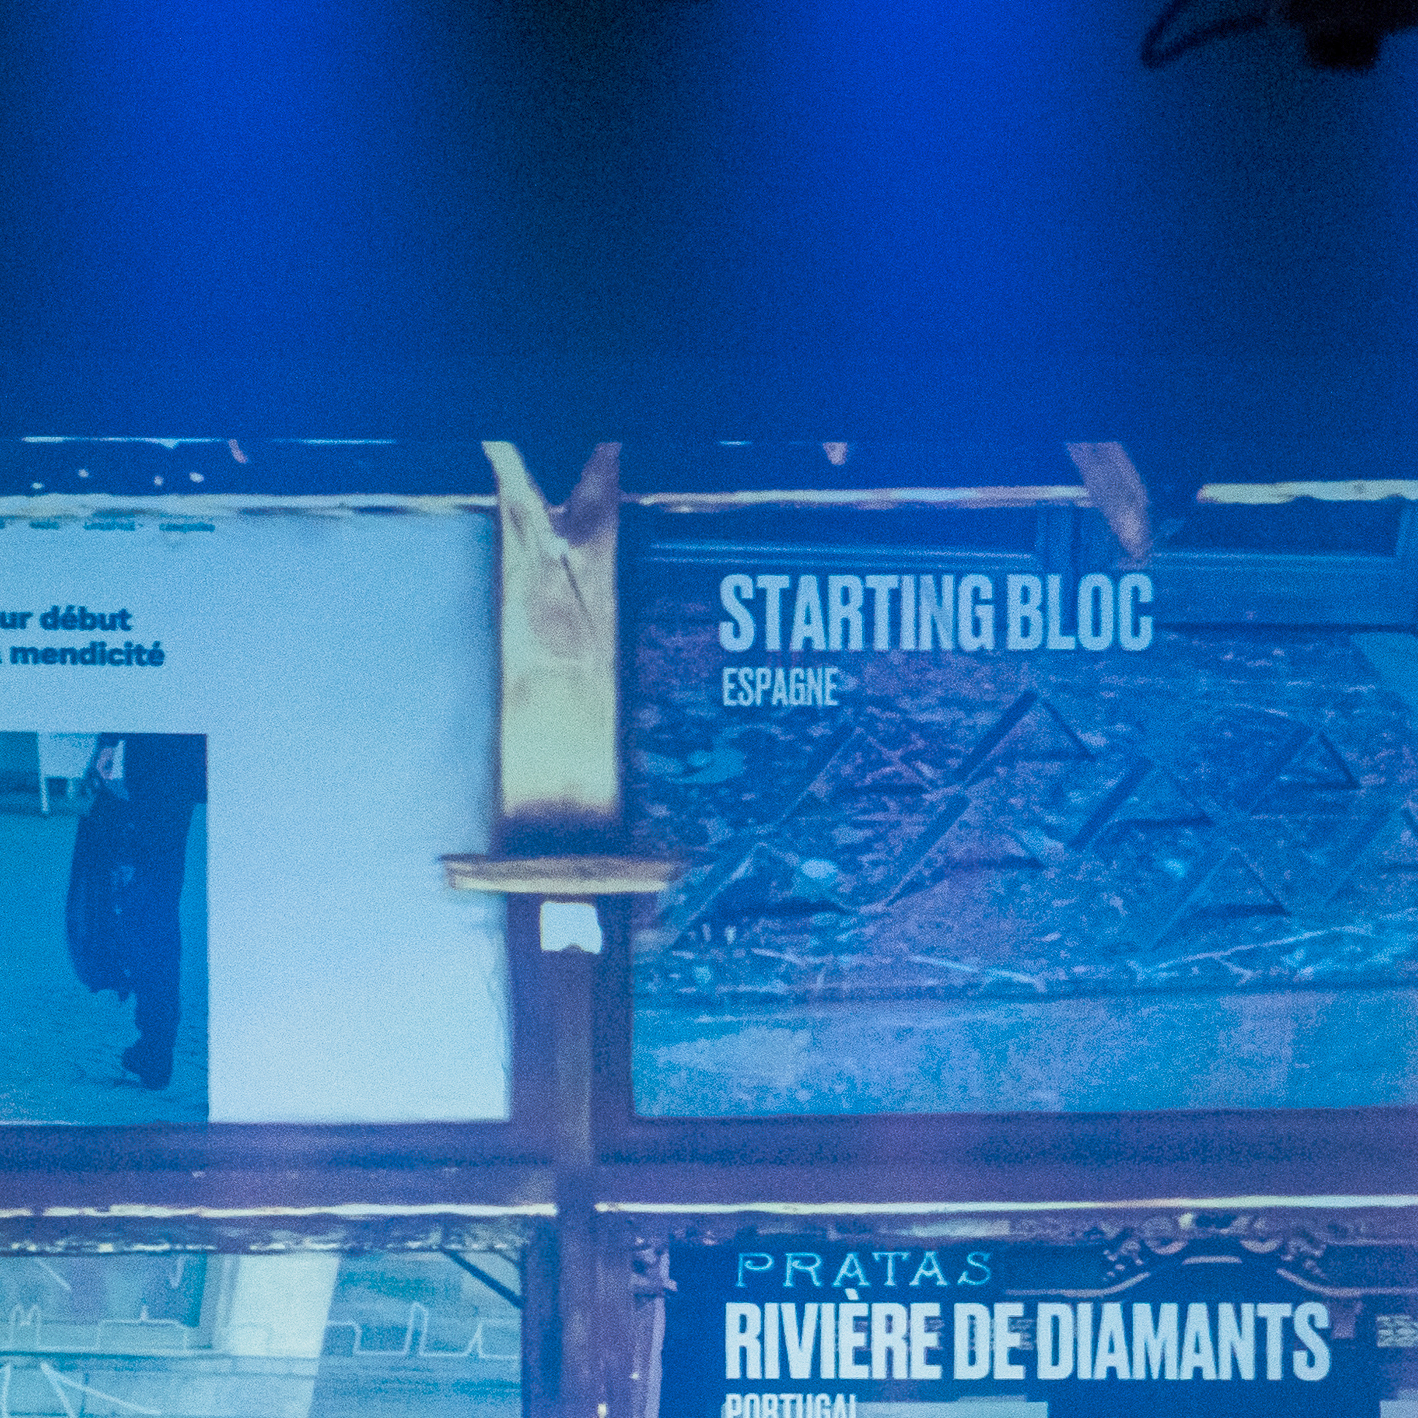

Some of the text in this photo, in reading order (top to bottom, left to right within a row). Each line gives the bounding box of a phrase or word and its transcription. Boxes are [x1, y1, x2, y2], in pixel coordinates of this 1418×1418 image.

[39, 604, 132, 631] début
[719, 573, 1154, 652] STARTING BLOC
[10, 640, 165, 667] mendicité
[722, 666, 840, 707] ESPAGNE
[735, 1250, 993, 1288] PRATAS
[725, 1288, 1332, 1382] RIVIÈRE DE DIAMANTS
